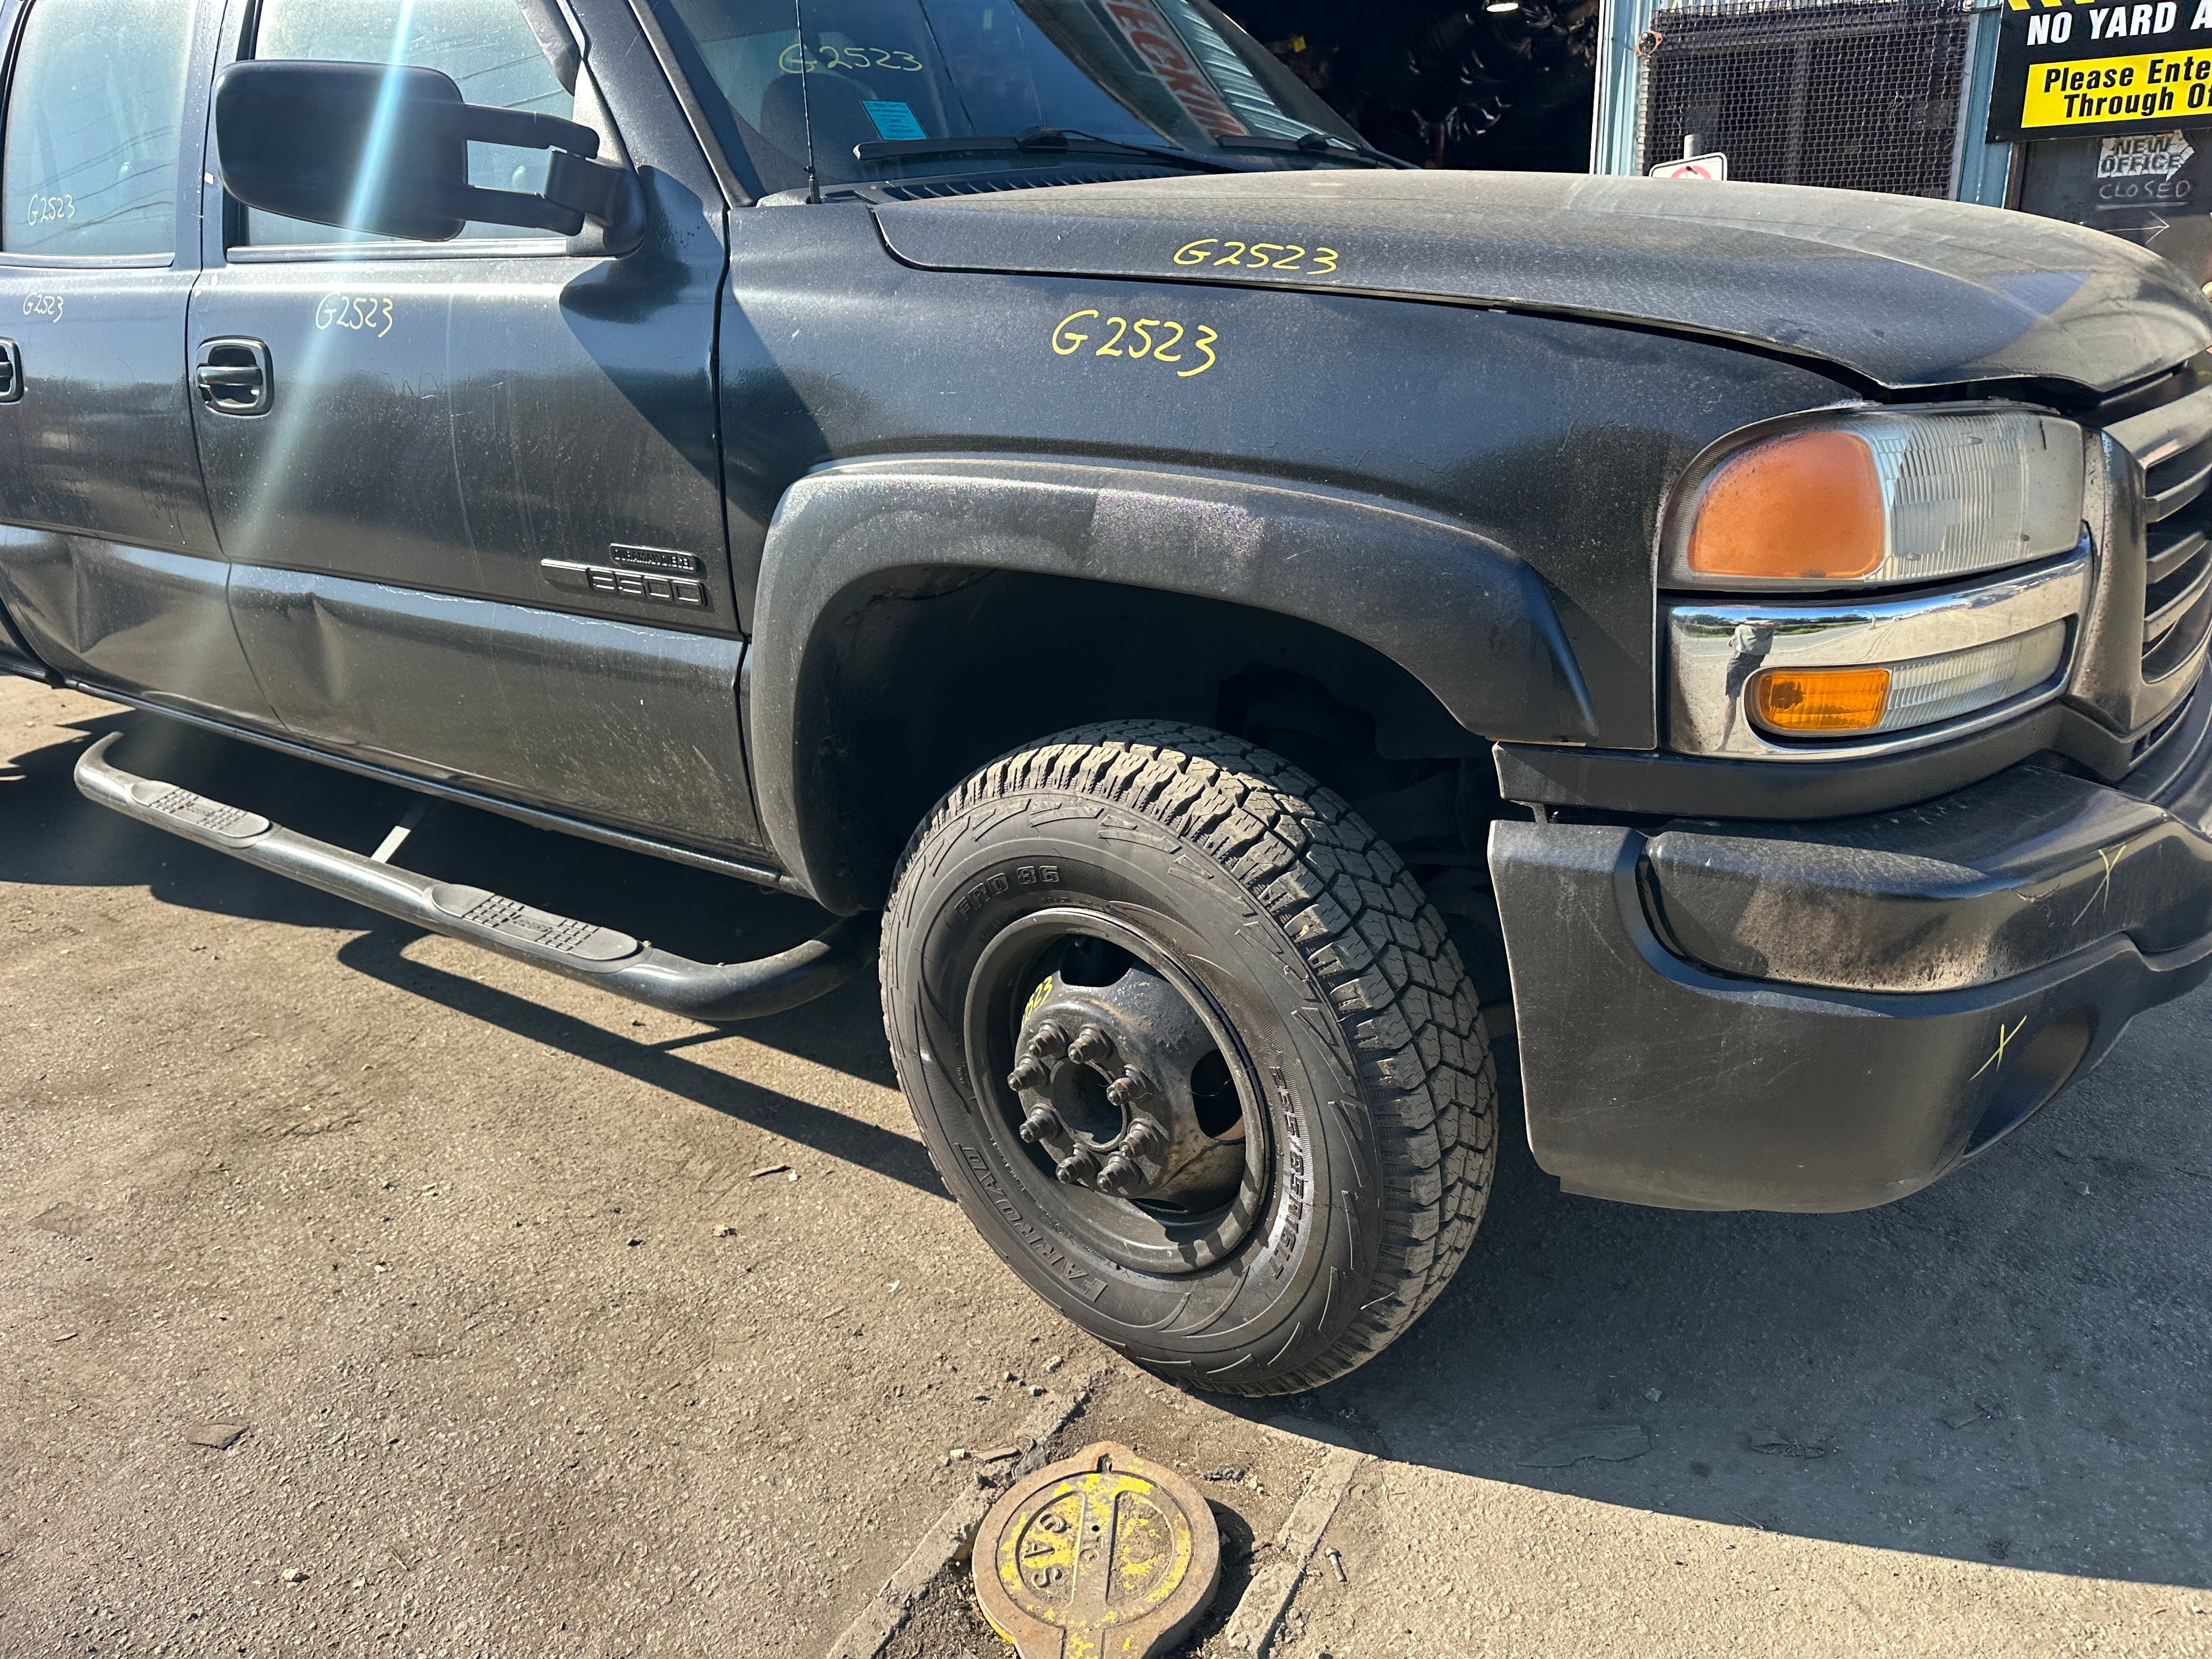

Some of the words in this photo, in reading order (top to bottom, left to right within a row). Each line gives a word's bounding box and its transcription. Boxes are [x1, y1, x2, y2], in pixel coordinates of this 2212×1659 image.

[2027, 12, 2073, 46] NO
[2089, 2, 2177, 40] YARD
[779, 43, 923, 72] G2523
[2044, 67, 2134, 93] Please
[2063, 86, 2175, 118] Through
[2115, 137, 2171, 154] NEW
[2100, 153, 2183, 173] OFFICE
[2100, 180, 2190, 199] CLOSED
[28, 194, 75, 226] G2523
[1173, 238, 1339, 275] G2523
[22, 291, 63, 323] G2523
[315, 291, 393, 338] G2523
[1052, 309, 1218, 377] G2523
[953, 872, 1009, 922] FRD
[1016, 865, 1060, 885] 86
[961, 1146, 1108, 1303] FARROAD
[1021, 1513, 1072, 1589] GAS
